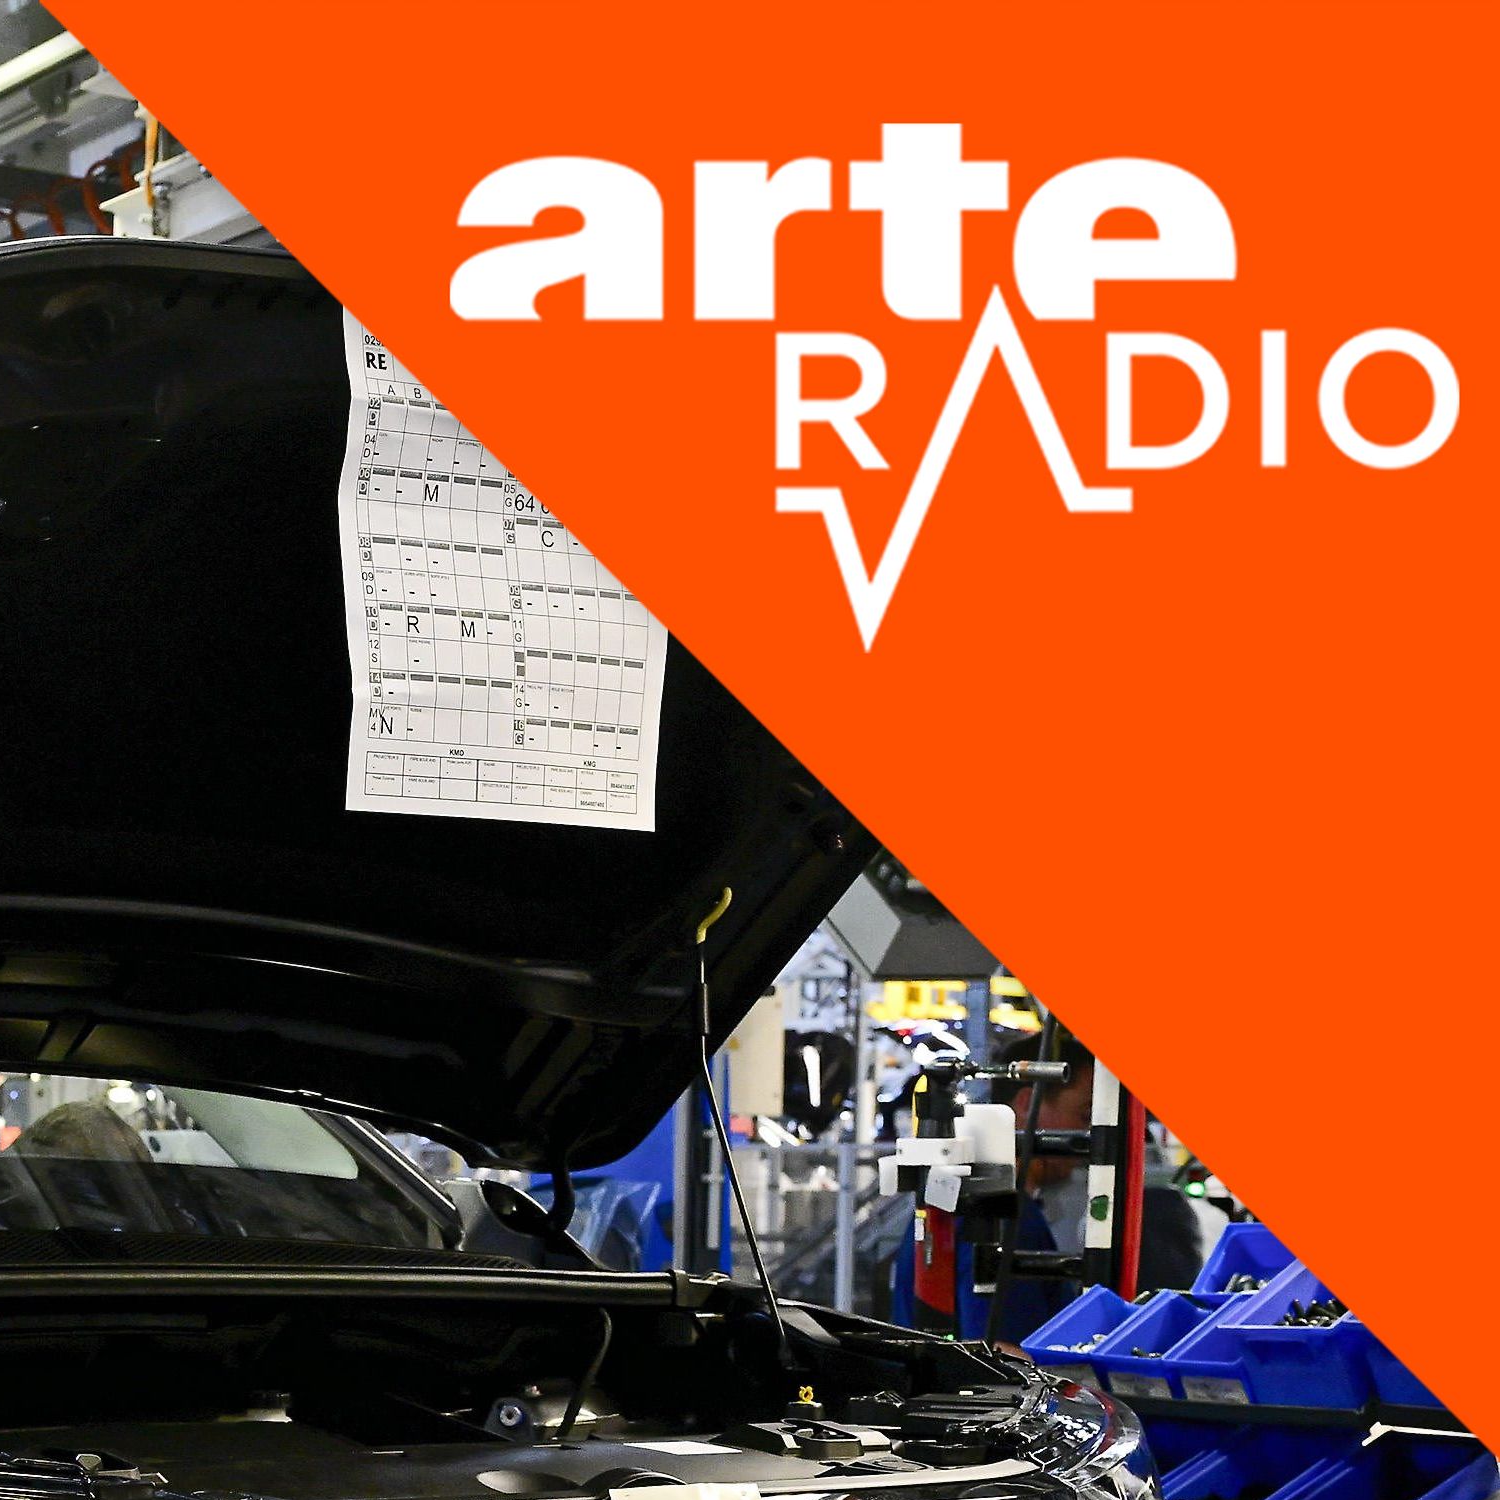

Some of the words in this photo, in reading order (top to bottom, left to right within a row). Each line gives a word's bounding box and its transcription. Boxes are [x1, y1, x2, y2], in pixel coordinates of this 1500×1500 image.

[366, 352, 387, 370] RE
[388, 385, 396, 395] A
[414, 388, 422, 398] B
[369, 398, 380, 408] 02
[364, 434, 376, 444] 04
[363, 448, 371, 458] D
[360, 468, 370, 478] 06
[424, 484, 439, 502] M
[504, 484, 516, 494] 05
[505, 497, 512, 507] G
[515, 494, 535, 512] 64
[359, 537, 371, 548] 08
[542, 531, 554, 547] C
[362, 572, 374, 581] 09
[366, 585, 373, 594] D
[366, 606, 377, 617] 10
[407, 616, 420, 633] R
[461, 620, 476, 638] M
[513, 620, 523, 629] 11
[514, 632, 522, 642] G
[369, 639, 379, 649] 12
[371, 653, 378, 662] S
[370, 673, 380, 683] 14
[515, 684, 524, 694] 14
[515, 698, 523, 707] G
[370, 722, 376, 731] 4
[380, 716, 393, 734] N
[514, 720, 524, 731] 16
